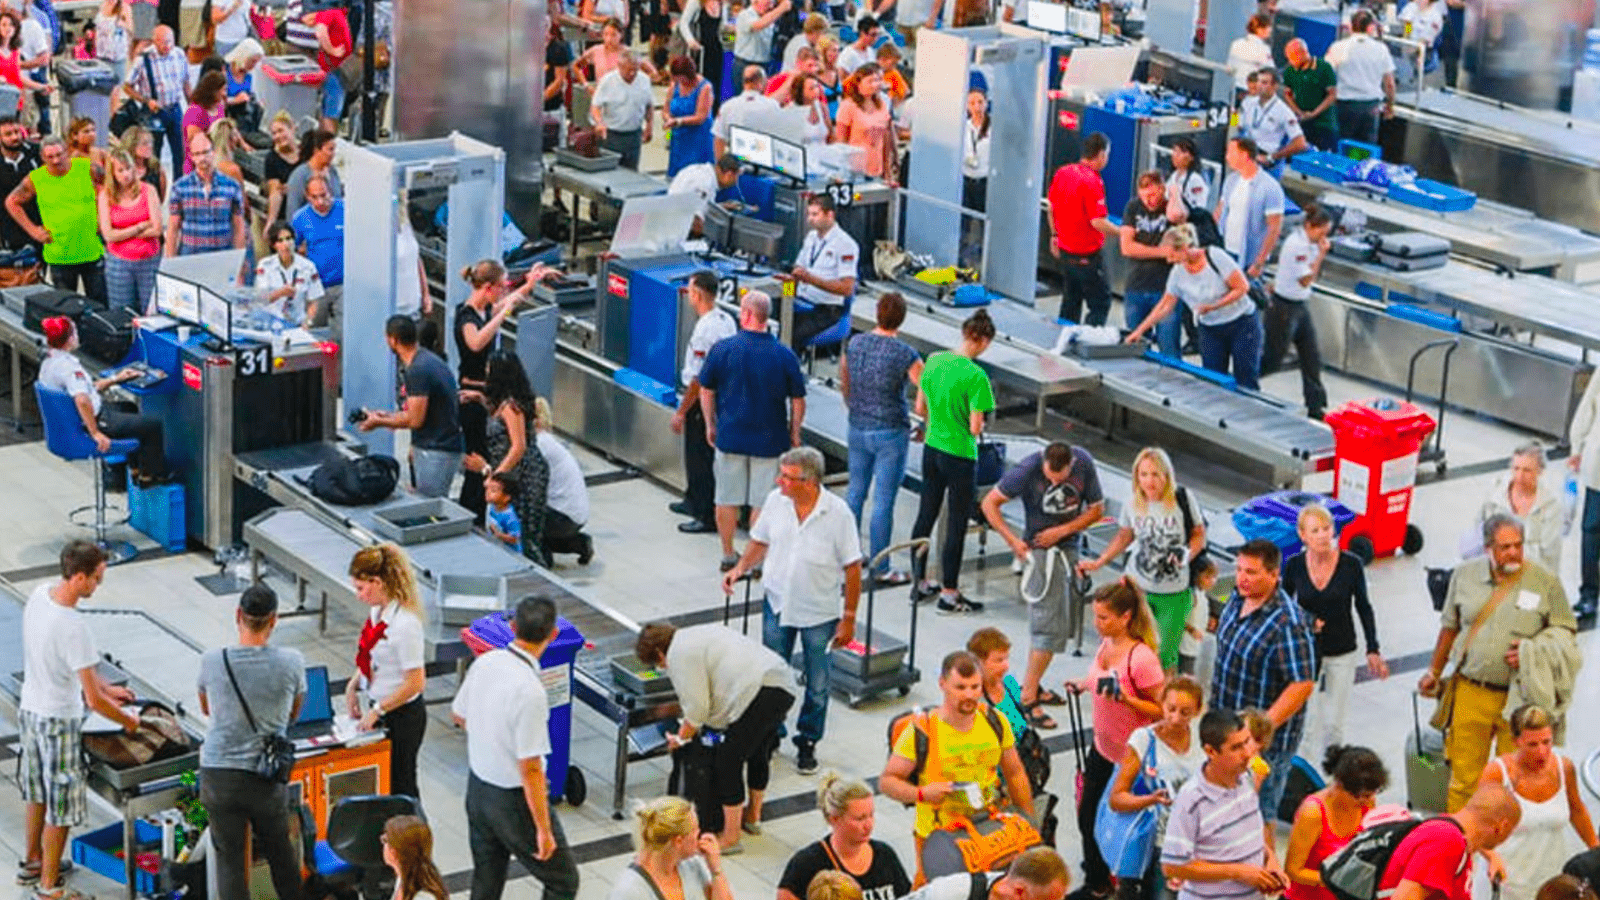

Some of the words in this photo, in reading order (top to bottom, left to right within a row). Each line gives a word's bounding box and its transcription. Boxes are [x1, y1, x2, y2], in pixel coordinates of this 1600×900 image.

[1209, 106, 1228, 127] 34
[829, 185, 850, 206] 33
[241, 349, 268, 374] 31
